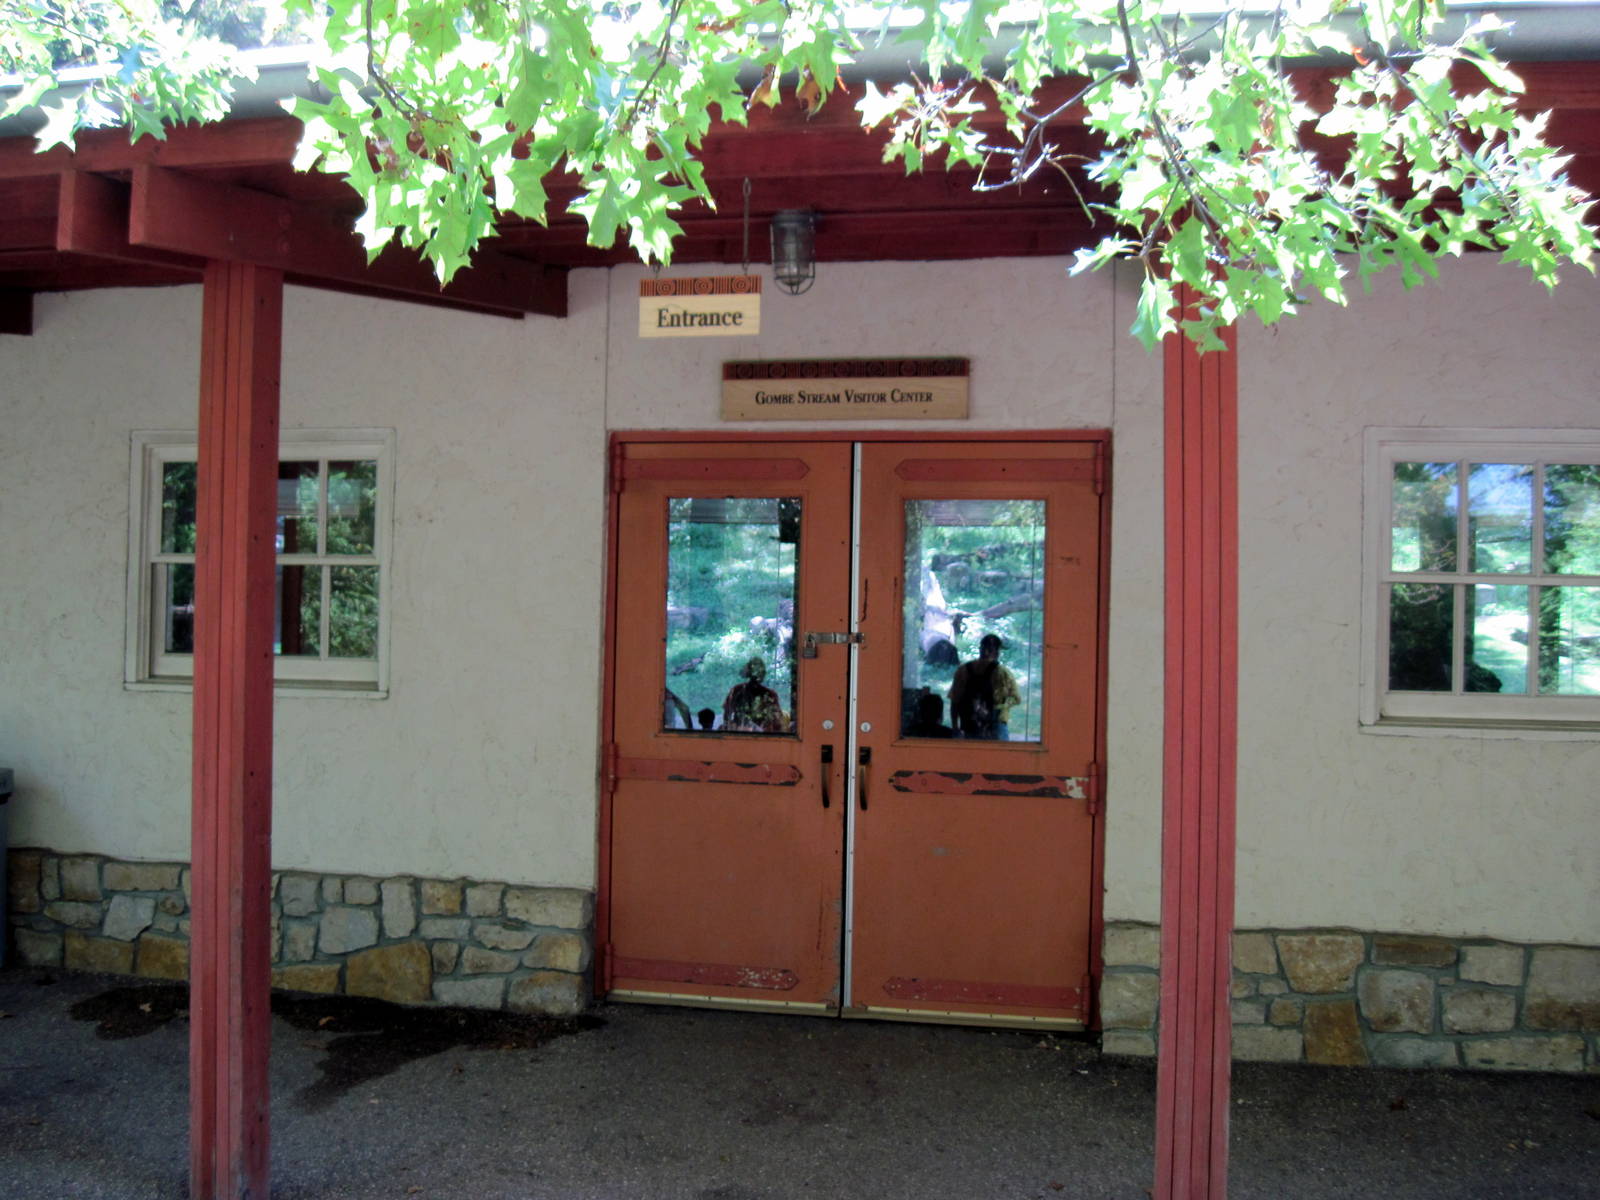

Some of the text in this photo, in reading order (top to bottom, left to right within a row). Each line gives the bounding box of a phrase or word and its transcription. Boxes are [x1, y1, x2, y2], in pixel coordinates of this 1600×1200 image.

[657, 308, 744, 329] Entrance
[755, 388, 934, 406] GOMBE STREAM VISITOR CENTER
